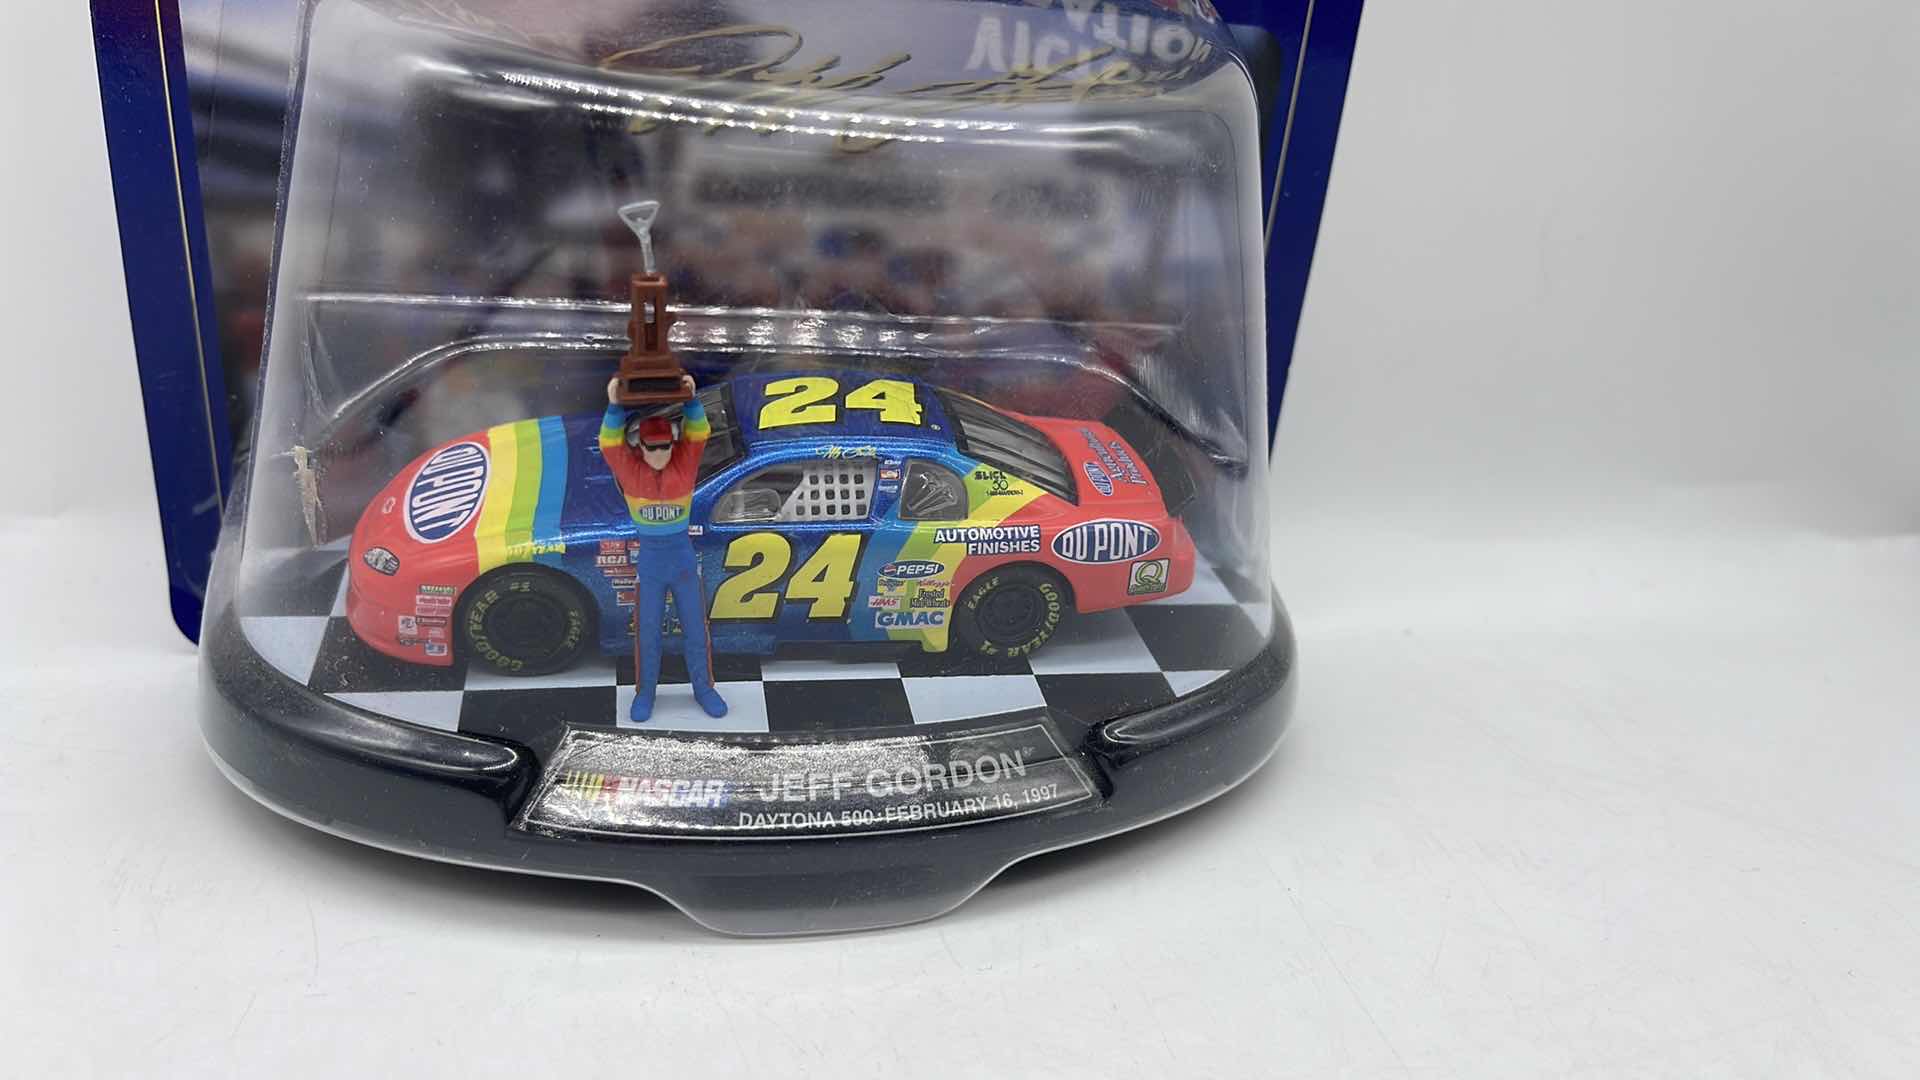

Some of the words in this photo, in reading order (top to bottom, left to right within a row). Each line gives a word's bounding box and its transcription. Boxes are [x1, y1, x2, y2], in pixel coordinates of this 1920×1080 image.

[758, 376, 923, 430] 24
[934, 525, 1040, 543] AUTOMOTIVE
[968, 539, 1041, 555] FINISHES
[596, 555, 627, 565] RCA
[896, 563, 939, 576] PEPSI
[708, 532, 863, 620] 24
[877, 611, 945, 626] GMAC
[759, 771, 855, 802] JEFF
[865, 749, 1028, 799] GORDON
[614, 776, 729, 808] NASCAR
[739, 811, 836, 829] DAYTONA
[1023, 783, 1059, 804] 1997
